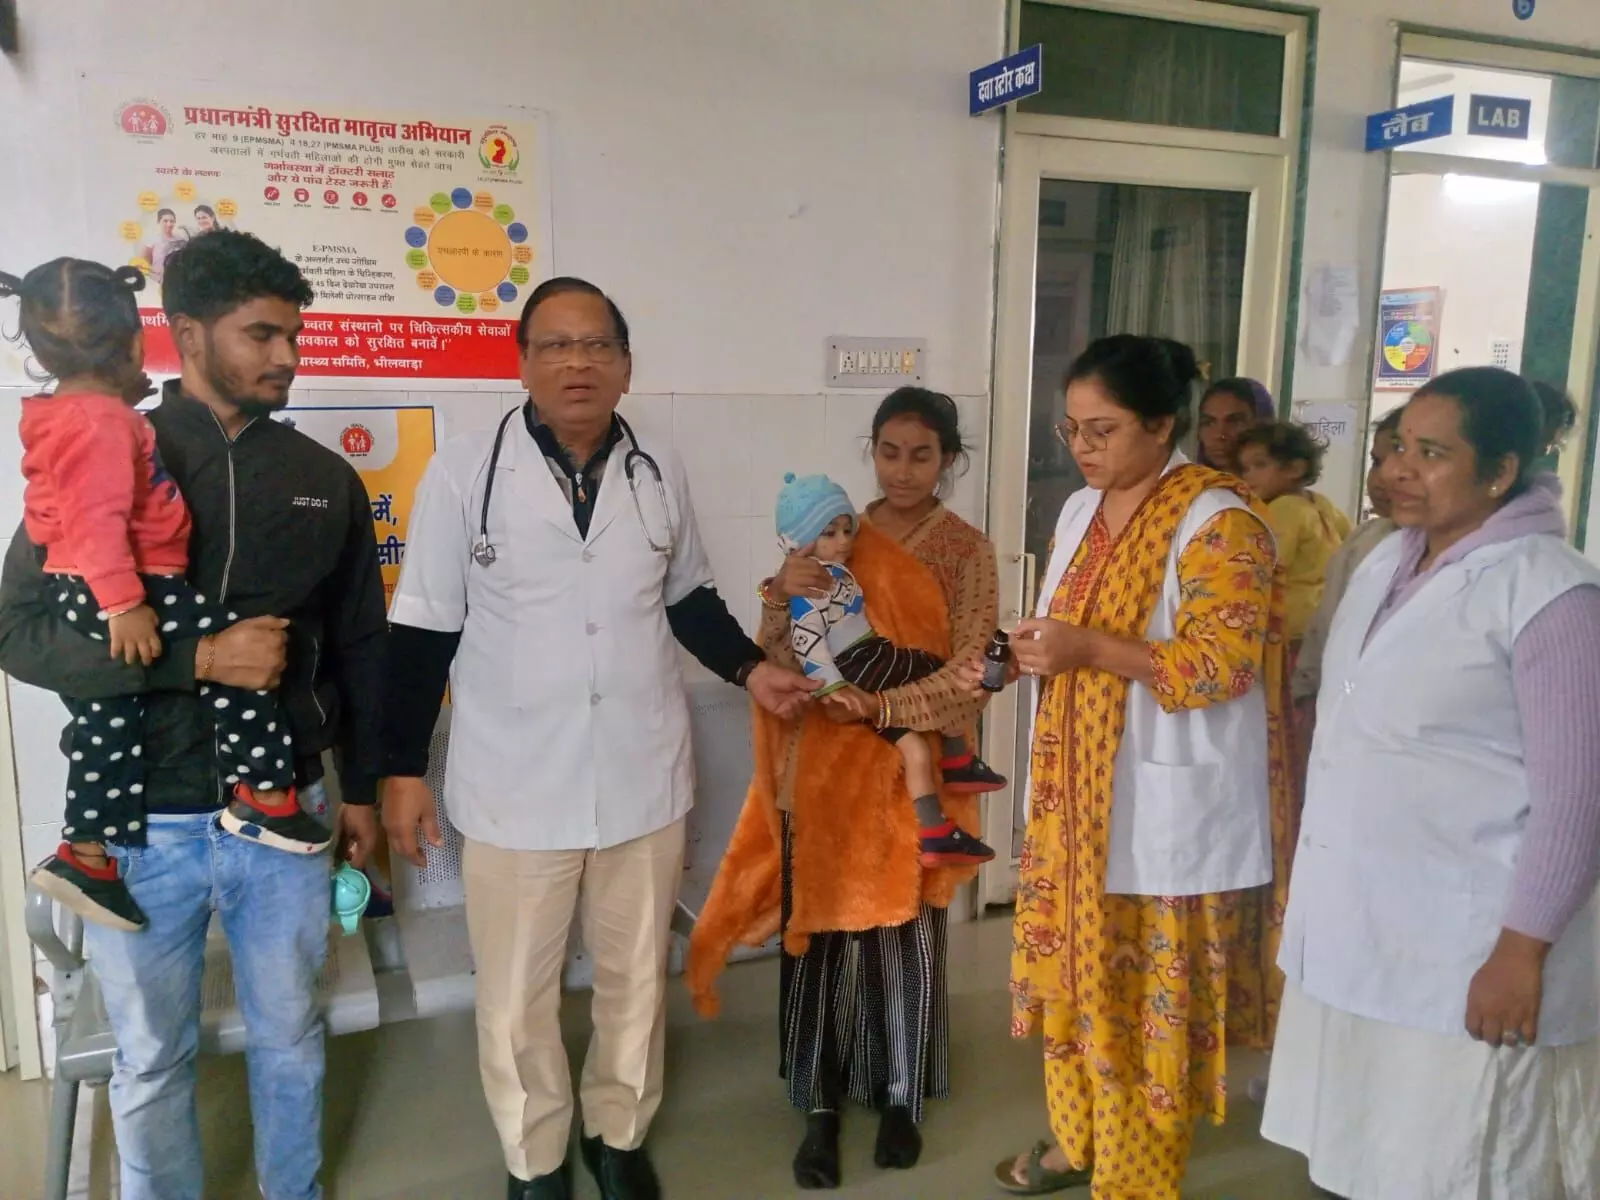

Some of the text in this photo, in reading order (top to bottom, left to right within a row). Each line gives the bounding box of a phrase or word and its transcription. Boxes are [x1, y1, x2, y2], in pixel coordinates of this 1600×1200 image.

[977, 61, 1036, 103] दवा स्टोर कक्ष
[184, 105, 272, 130] प्रधानमंत्री
[275, 111, 341, 136] सुरक्षित
[344, 119, 397, 143] मातृत्व
[401, 121, 472, 145] अभियान
[1381, 111, 1435, 140] लैब
[1477, 105, 1521, 129] LAB
[303, 320, 333, 332] च्चतर
[389, 323, 404, 334] पर
[296, 335, 338, 348] सवकाल
[344, 333, 360, 348] को
[366, 334, 405, 352] सुरक्षित
[292, 496, 310, 507] JUST
[310, 498, 321, 508] DO
